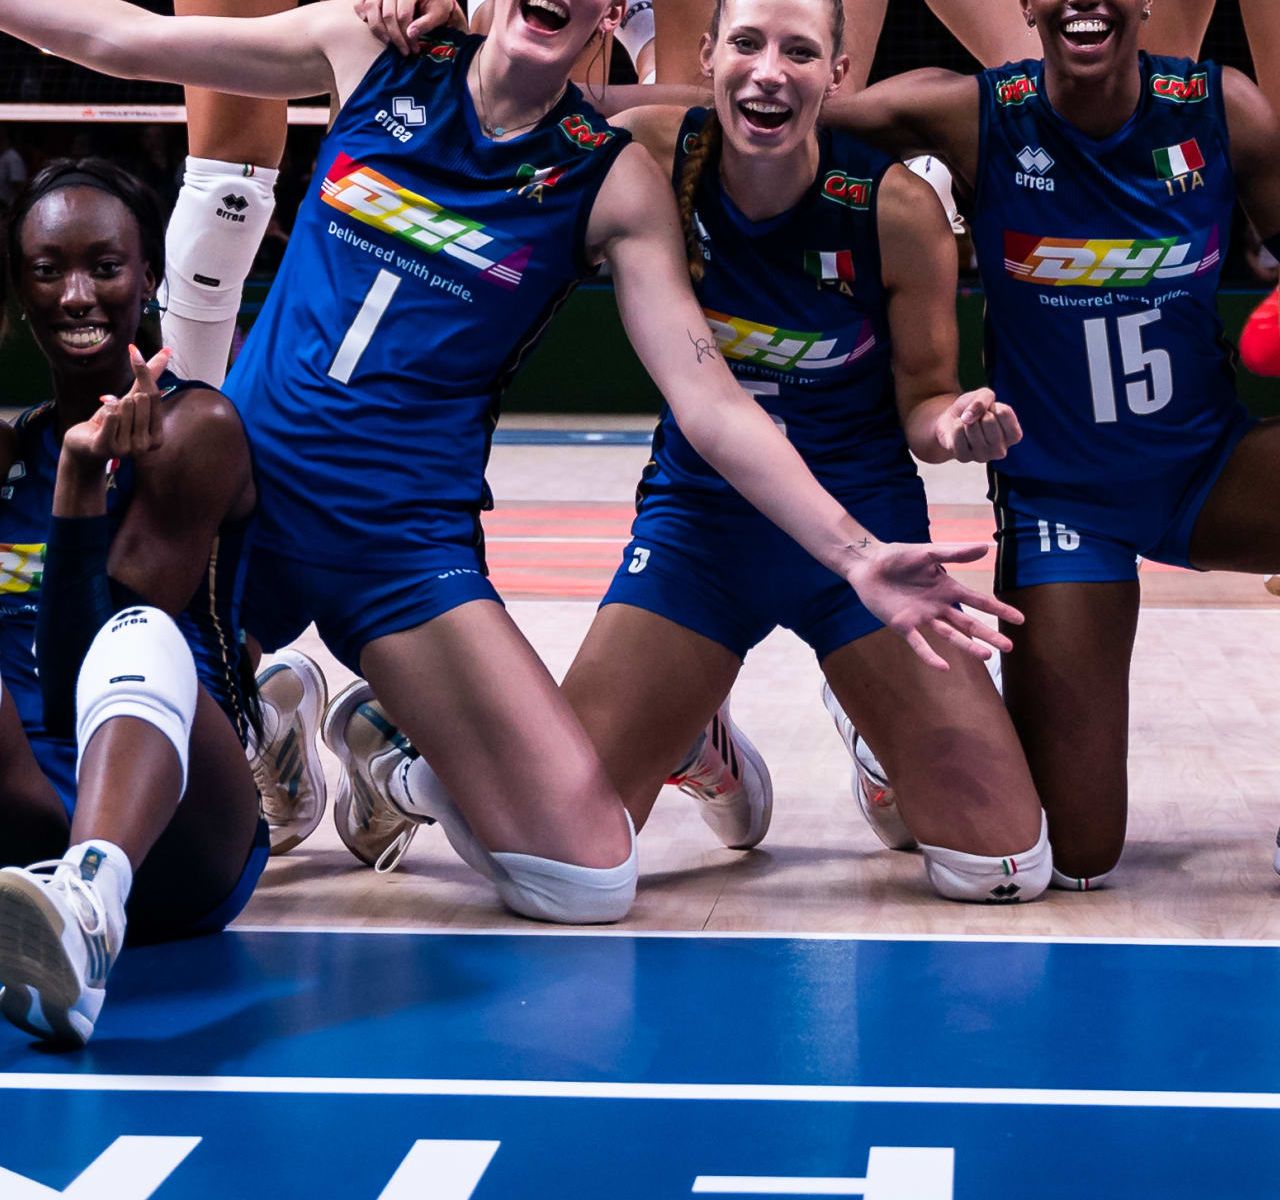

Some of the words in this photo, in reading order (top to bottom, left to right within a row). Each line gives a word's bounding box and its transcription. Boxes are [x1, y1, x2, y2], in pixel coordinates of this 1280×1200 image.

[374, 108, 414, 144] errea
[1015, 171, 1056, 193] errea
[1166, 170, 1206, 197] ITA
[215, 208, 247, 224] errea
[334, 170, 499, 271] DHL
[327, 219, 396, 265] Delivered
[395, 251, 431, 282] with
[429, 272, 475, 305] pride.
[1032, 241, 1201, 280] DHL
[1038, 292, 1114, 308] Delivered
[327, 267, 403, 385] 1
[1083, 308, 1174, 424] 15
[1038, 519, 1081, 554] 15
[111, 617, 148, 634] errea
